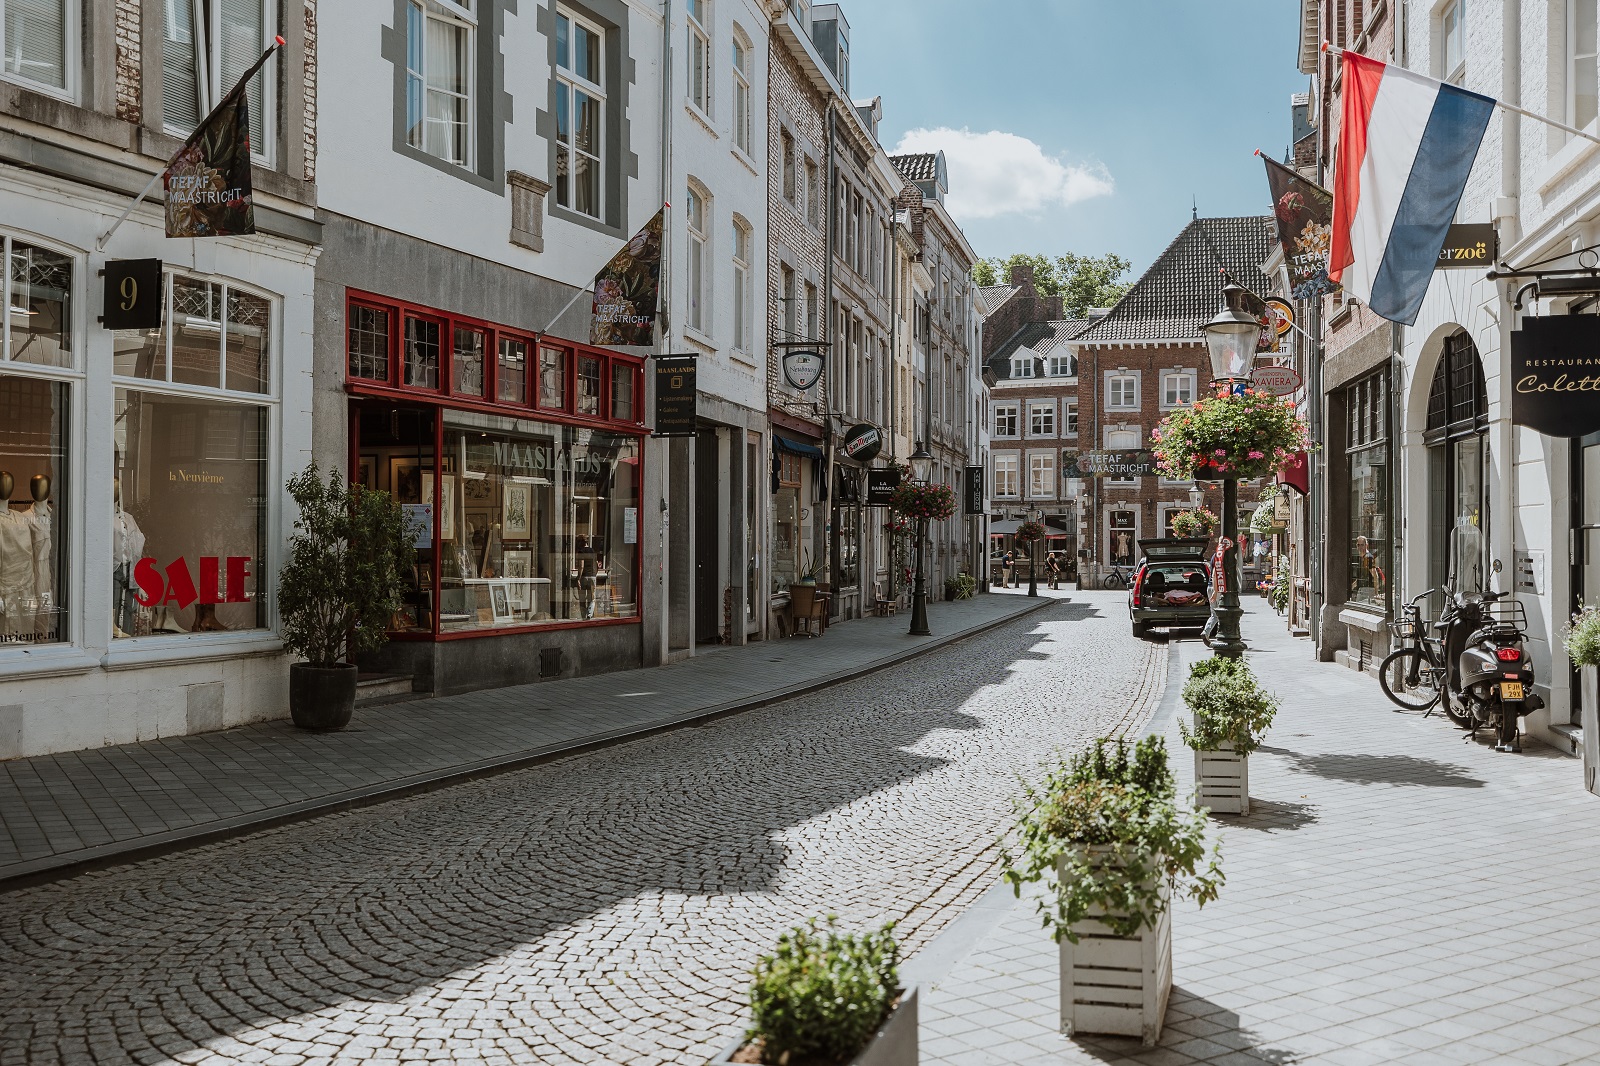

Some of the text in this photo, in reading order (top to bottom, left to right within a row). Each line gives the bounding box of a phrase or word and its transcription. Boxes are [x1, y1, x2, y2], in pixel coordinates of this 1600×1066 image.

[171, 176, 209, 189] TEFAF
[169, 188, 242, 204] MAASTRICHT
[1292, 249, 1329, 266] TEFAF
[1438, 241, 1487, 260] erzoë
[1294, 260, 1328, 276] MAAST
[120, 276, 138, 311] 9
[597, 304, 626, 314] TEFAF
[595, 314, 650, 324] MAASTRICHT
[657, 366, 696, 374] MAASLANDS
[1525, 358, 1600, 367] RESTAURAN
[1515, 373, 1600, 394] Colett
[1089, 454, 1122, 464] TEFAF
[1089, 463, 1150, 473] MAASTRICHT
[169, 469, 224, 484] la Neuvième
[133, 555, 252, 611] SALE
[1214, 561, 1225, 593] BIKES
